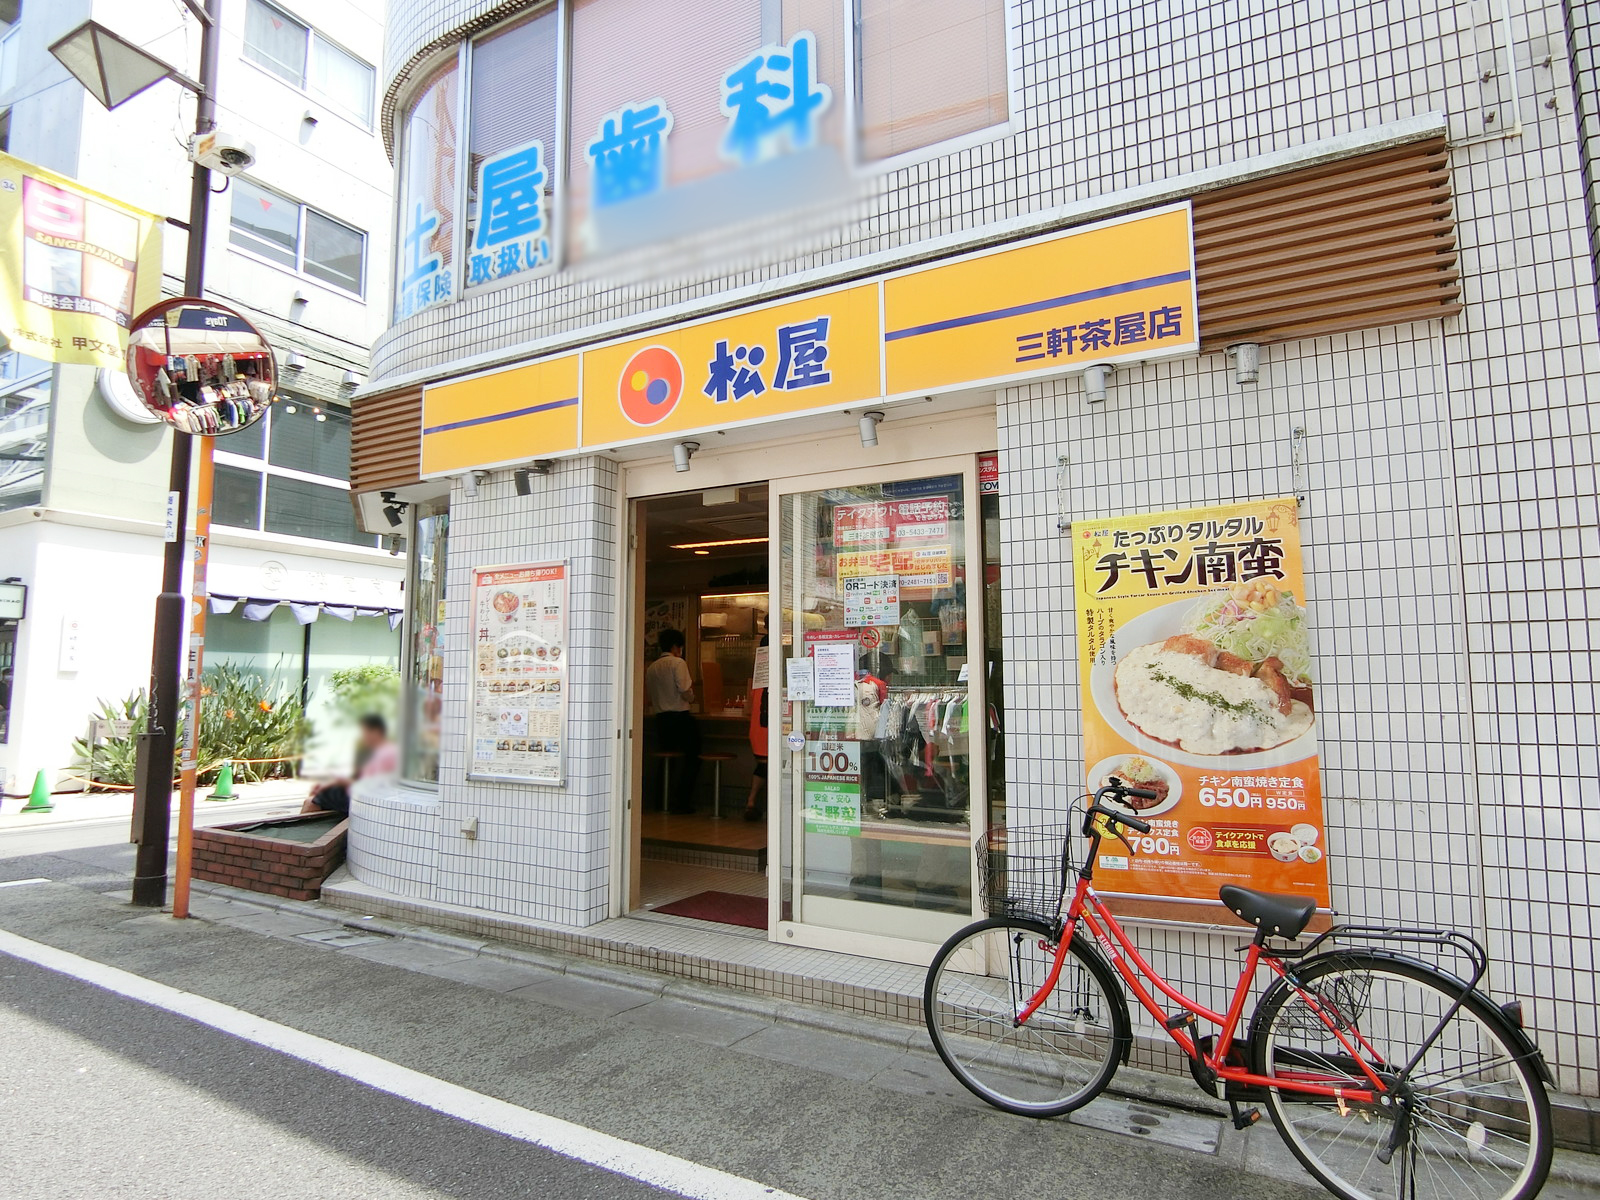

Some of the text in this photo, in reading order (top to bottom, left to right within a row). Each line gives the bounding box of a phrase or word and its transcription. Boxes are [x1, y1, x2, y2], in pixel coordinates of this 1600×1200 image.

[3, 179, 15, 191] 34
[36, 231, 125, 267] SANGENJAYA
[1015, 306, 1182, 363] 三軒茶屋店
[703, 317, 831, 402] 松屋
[1112, 516, 1264, 549] たっぷりタルタル
[1095, 538, 1285, 594] チキン南蛮
[845, 580, 897, 591] QRコード決済
[808, 751, 858, 773] 100%
[1198, 775, 1304, 789] チキン南蛮焼き定食
[813, 793, 851, 803] 安全・安心
[1198, 787, 1306, 810] 650円 950円
[1127, 836, 1180, 856] 790円
[1215, 831, 1265, 841] テイクアウトで
[1215, 840, 1256, 850] 食卓を応援
